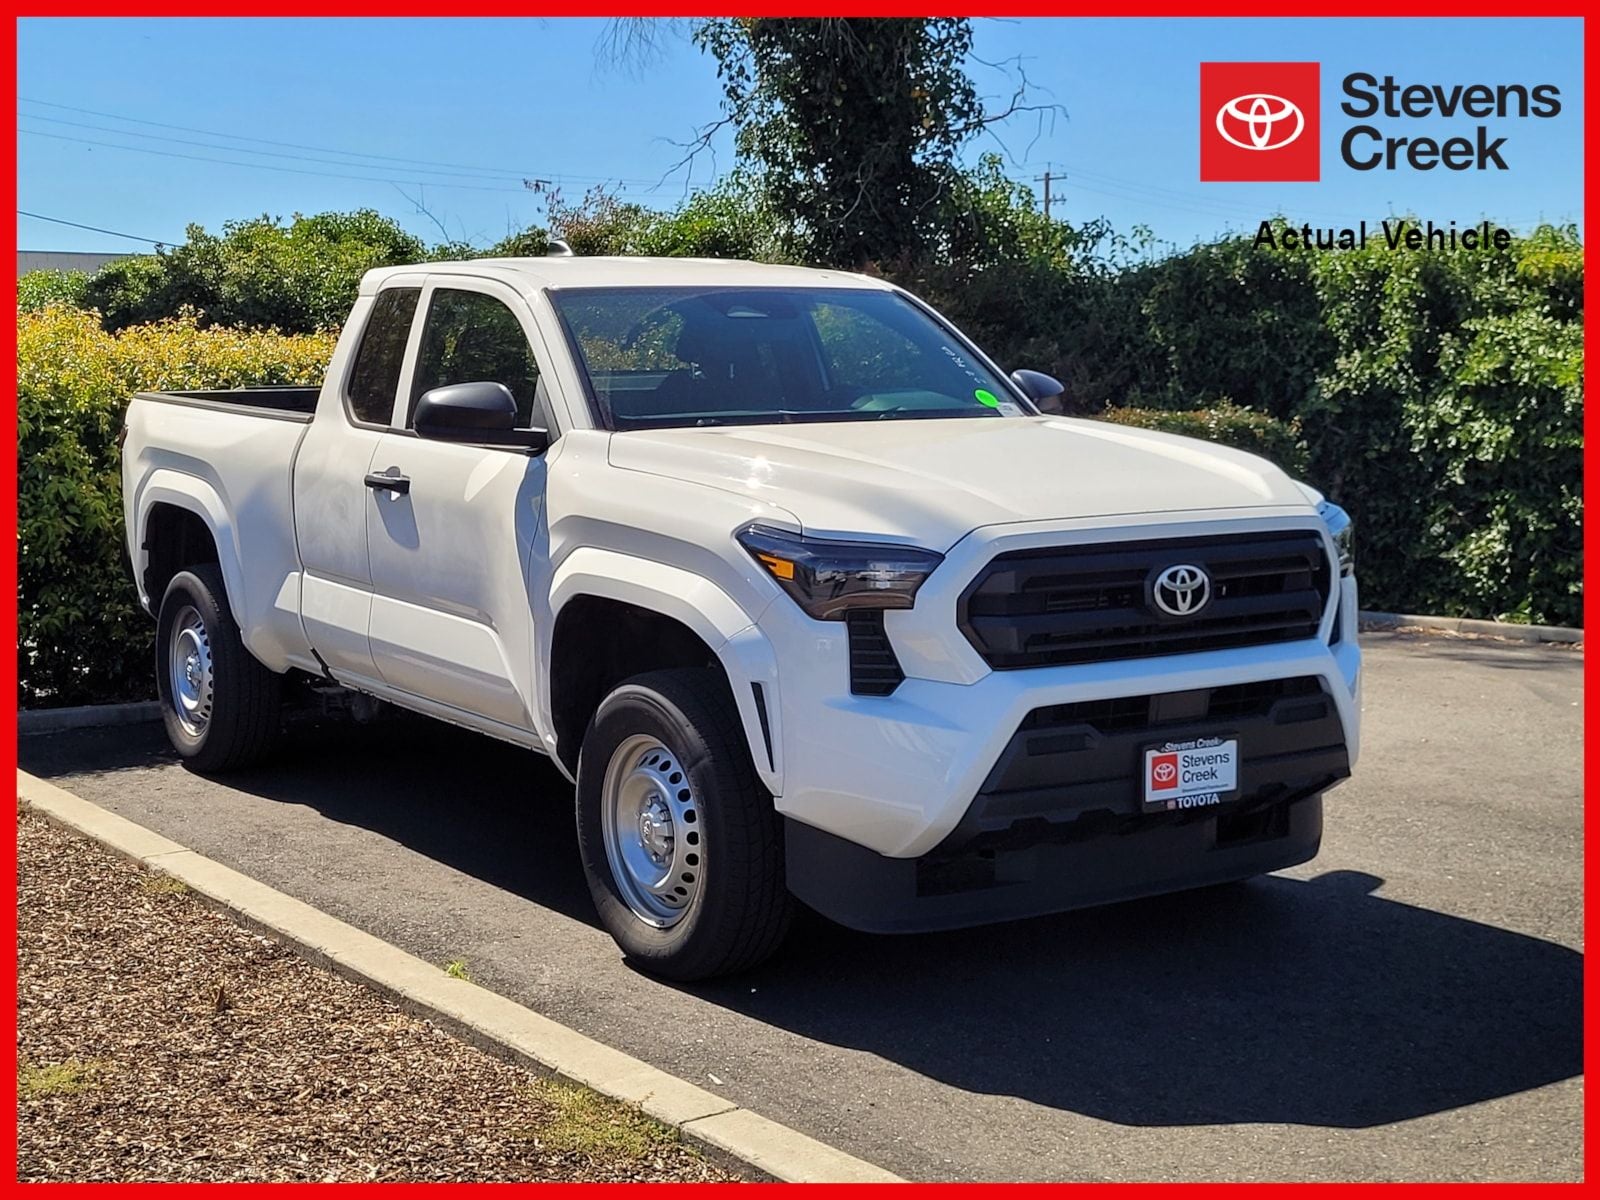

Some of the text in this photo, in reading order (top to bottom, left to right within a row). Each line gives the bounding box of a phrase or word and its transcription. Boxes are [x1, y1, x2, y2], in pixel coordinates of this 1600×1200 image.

[1164, 736, 1219, 752] Stevens Creek
[1181, 752, 1230, 768] Stevens
[1181, 766, 1218, 783] Creek
[1177, 793, 1221, 809] TOYOTA
